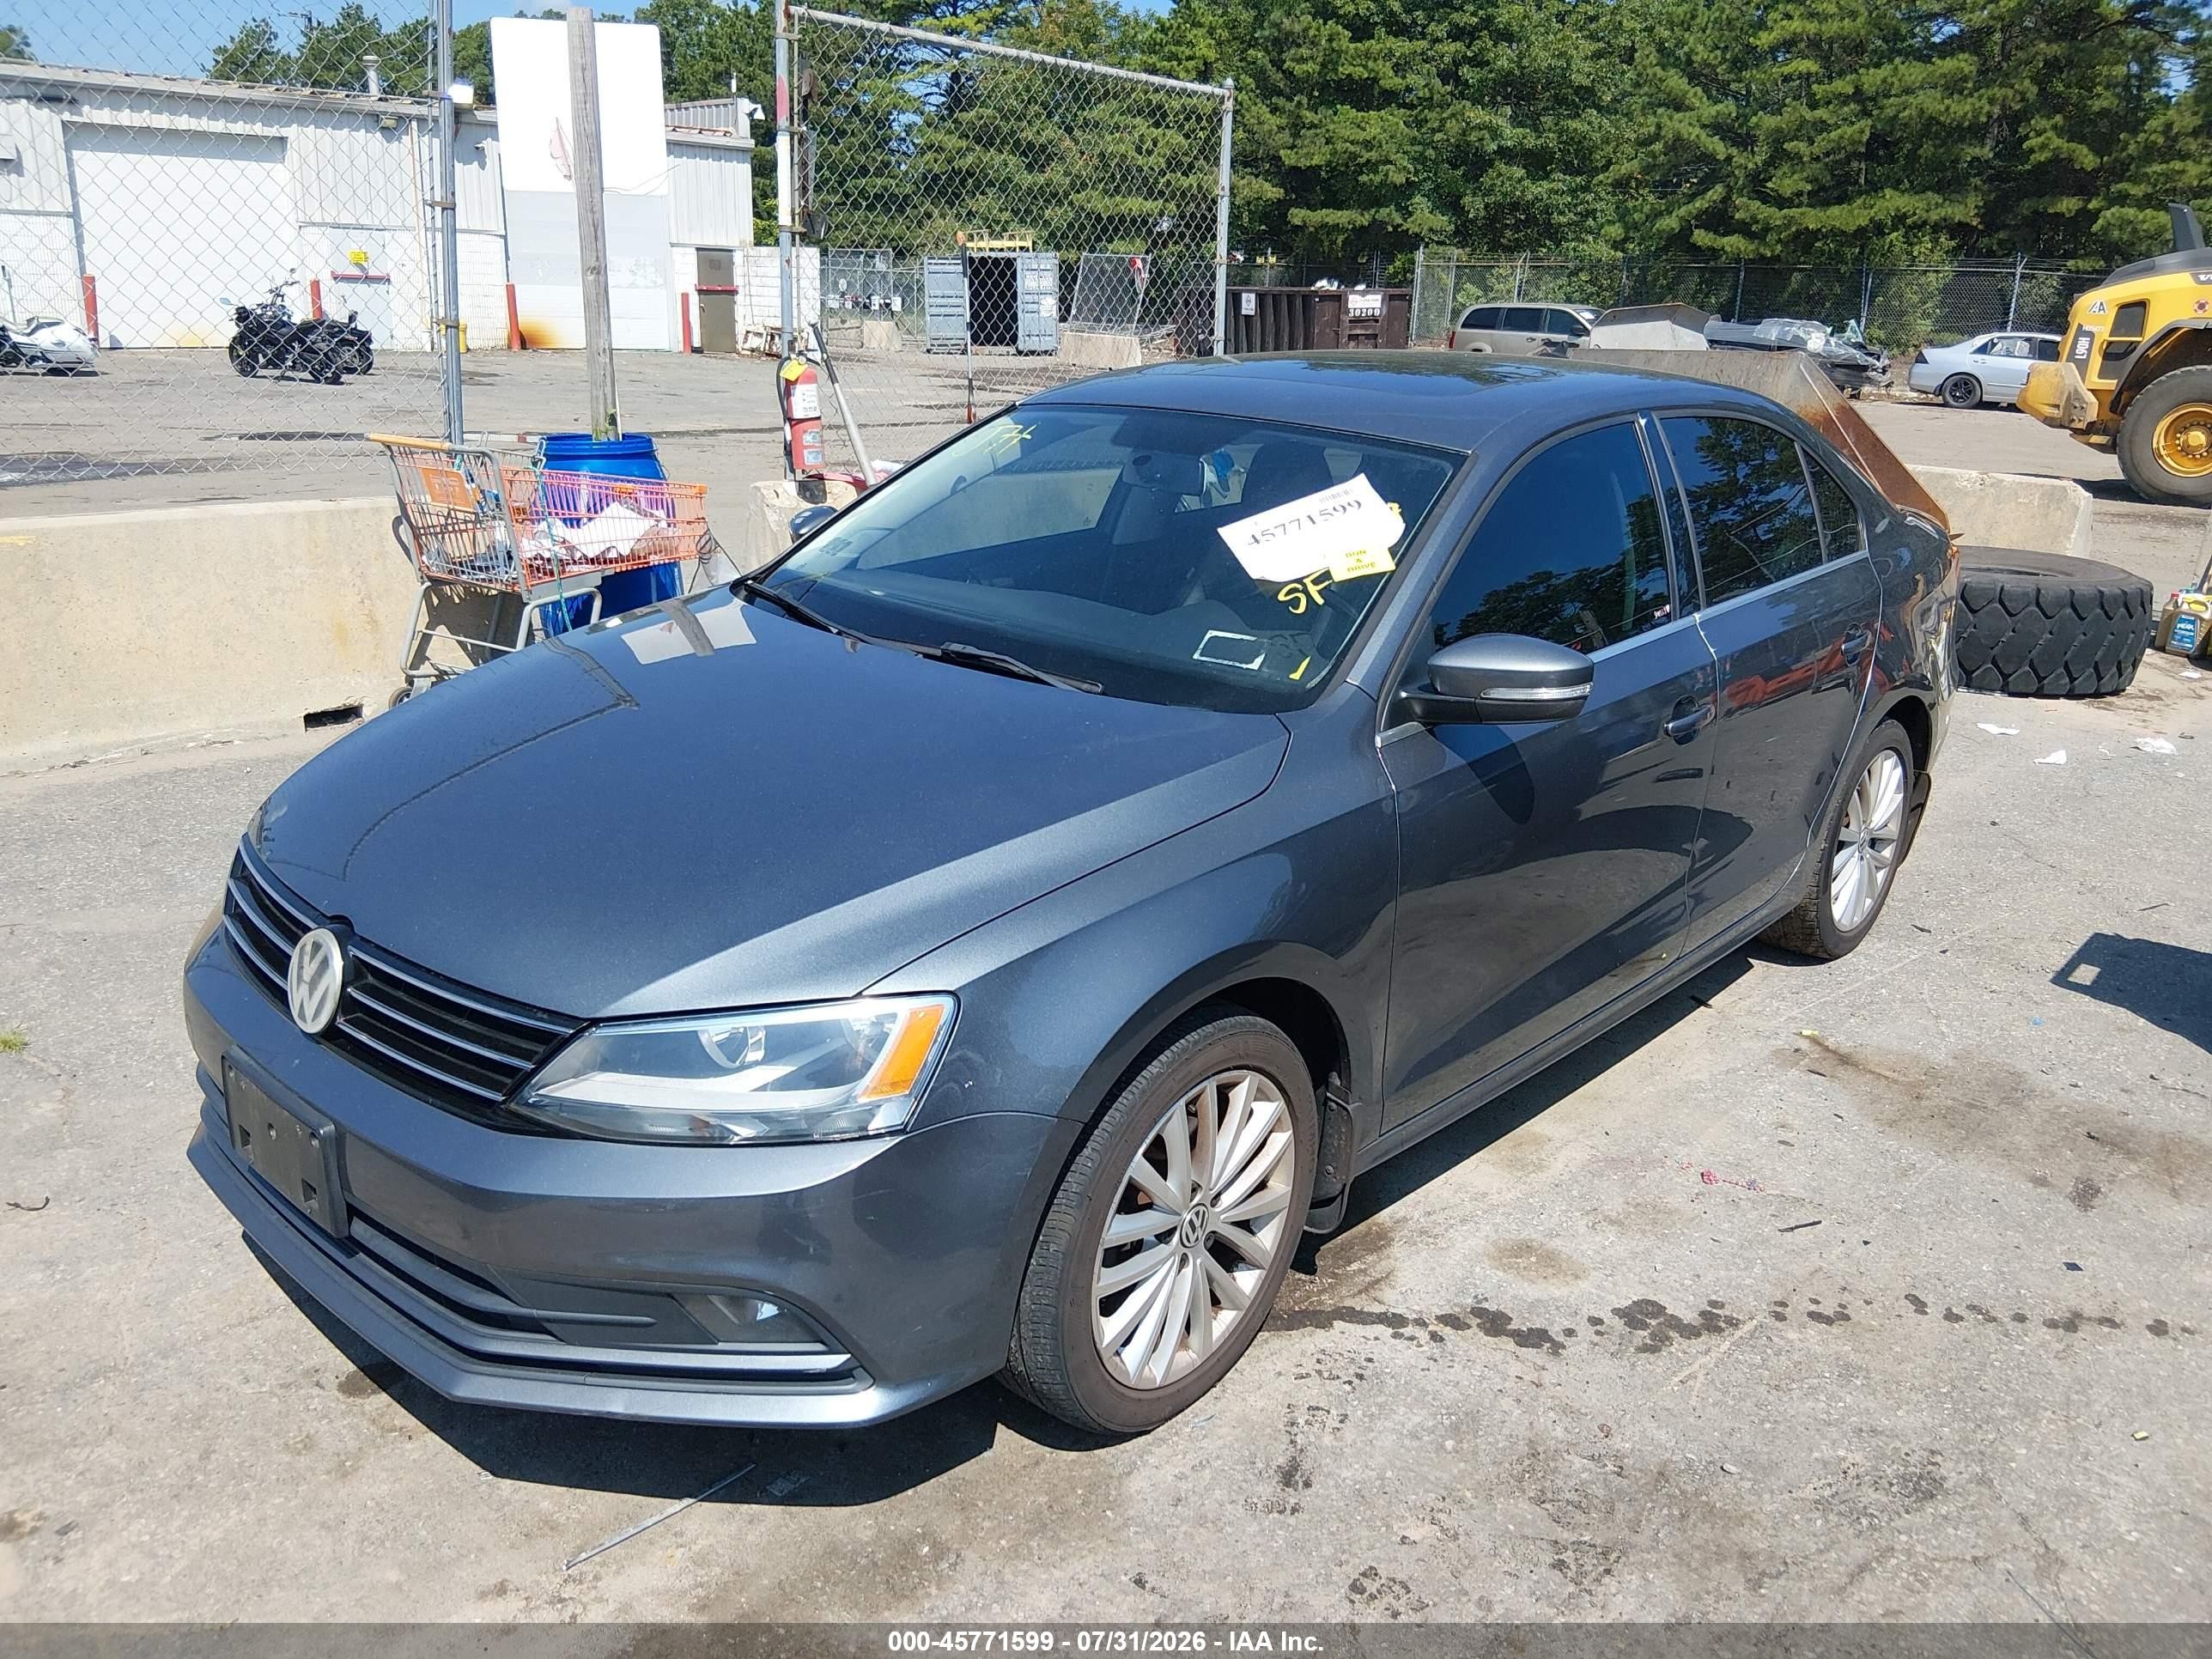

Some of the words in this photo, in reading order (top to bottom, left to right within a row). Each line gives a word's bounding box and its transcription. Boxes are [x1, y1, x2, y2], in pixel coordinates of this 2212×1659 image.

[1348, 308, 1381, 317] 30200
[2075, 337, 2091, 359] L90H
[1247, 500, 1362, 545] 45771599
